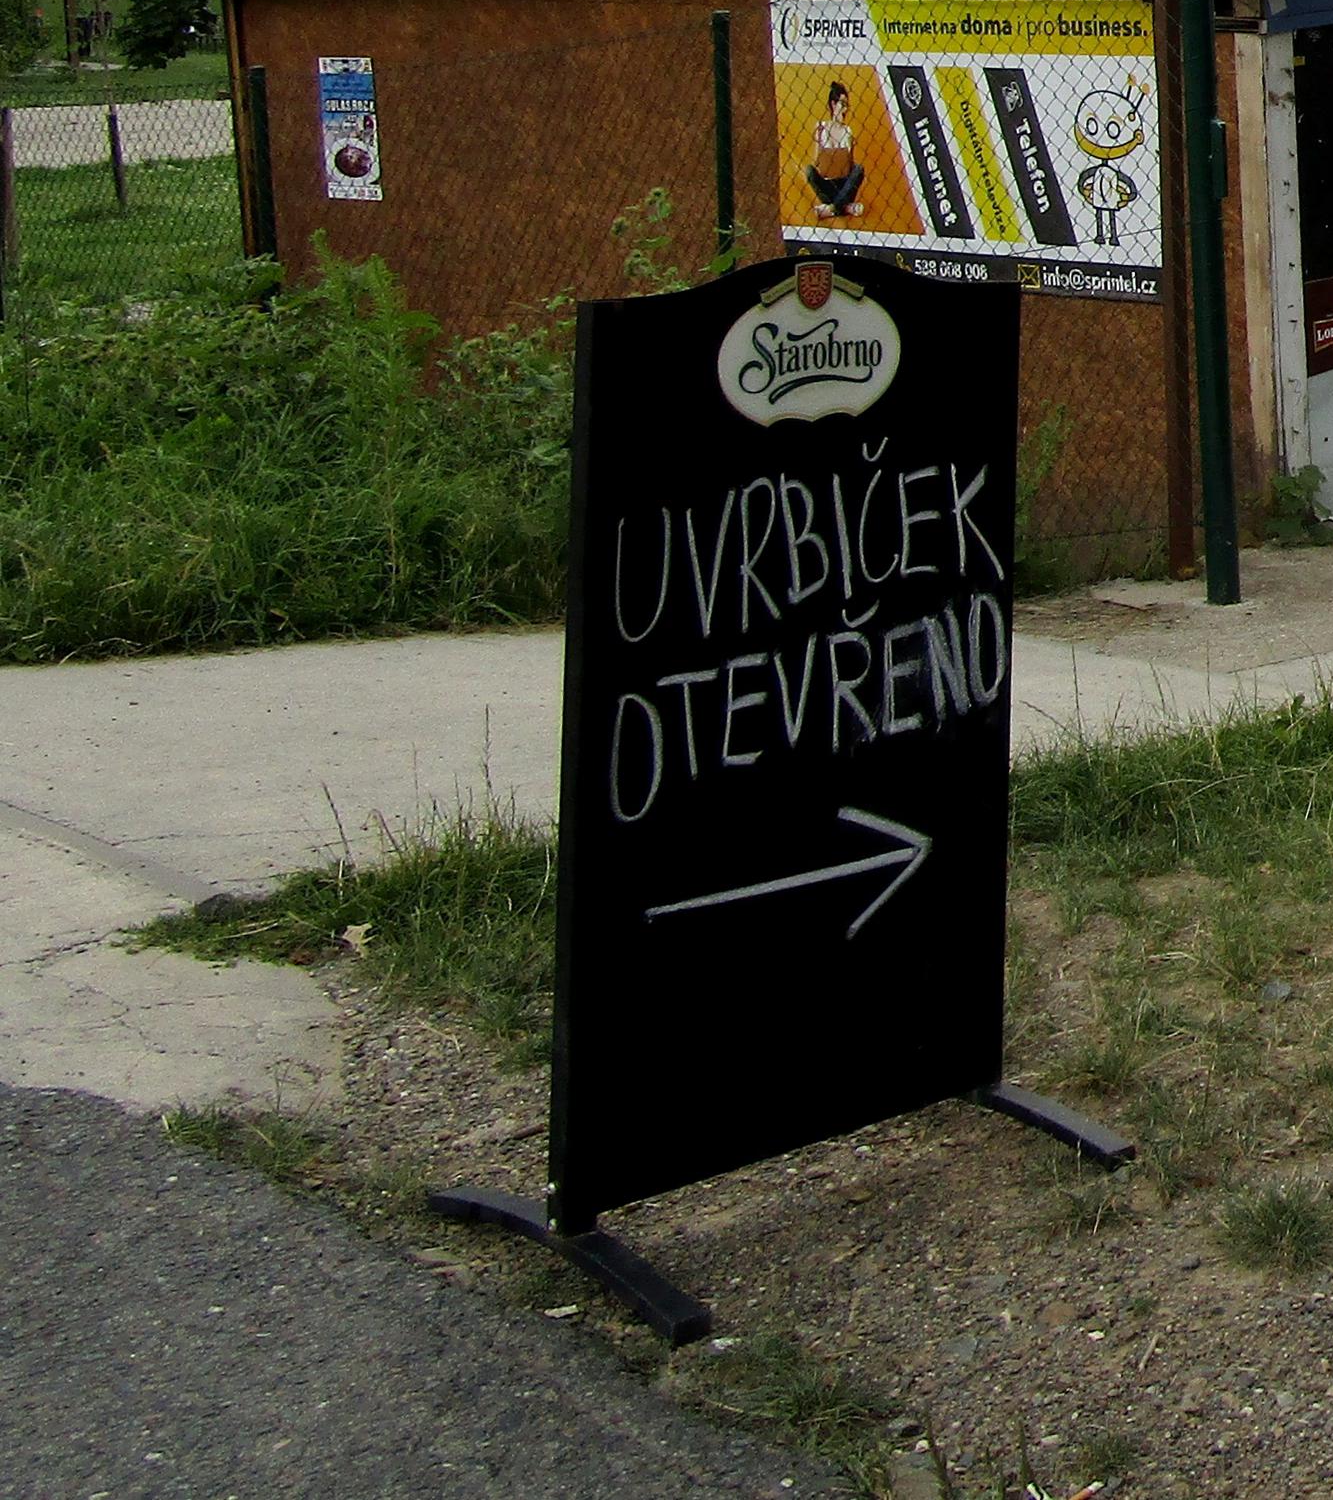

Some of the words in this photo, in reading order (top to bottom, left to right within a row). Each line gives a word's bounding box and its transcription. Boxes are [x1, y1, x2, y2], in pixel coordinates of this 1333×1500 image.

[883, 18, 933, 35] Internet
[940, 22, 957, 35] na
[961, 14, 1013, 35] doma
[1058, 15, 1149, 38] business.
[915, 117, 958, 228] Internet
[1016, 117, 1051, 214] Telefon
[1042, 267, 1157, 294] info@sprintel.cz
[739, 318, 882, 404] Starobrno
[610, 592, 1008, 823] OTEVŘENO
